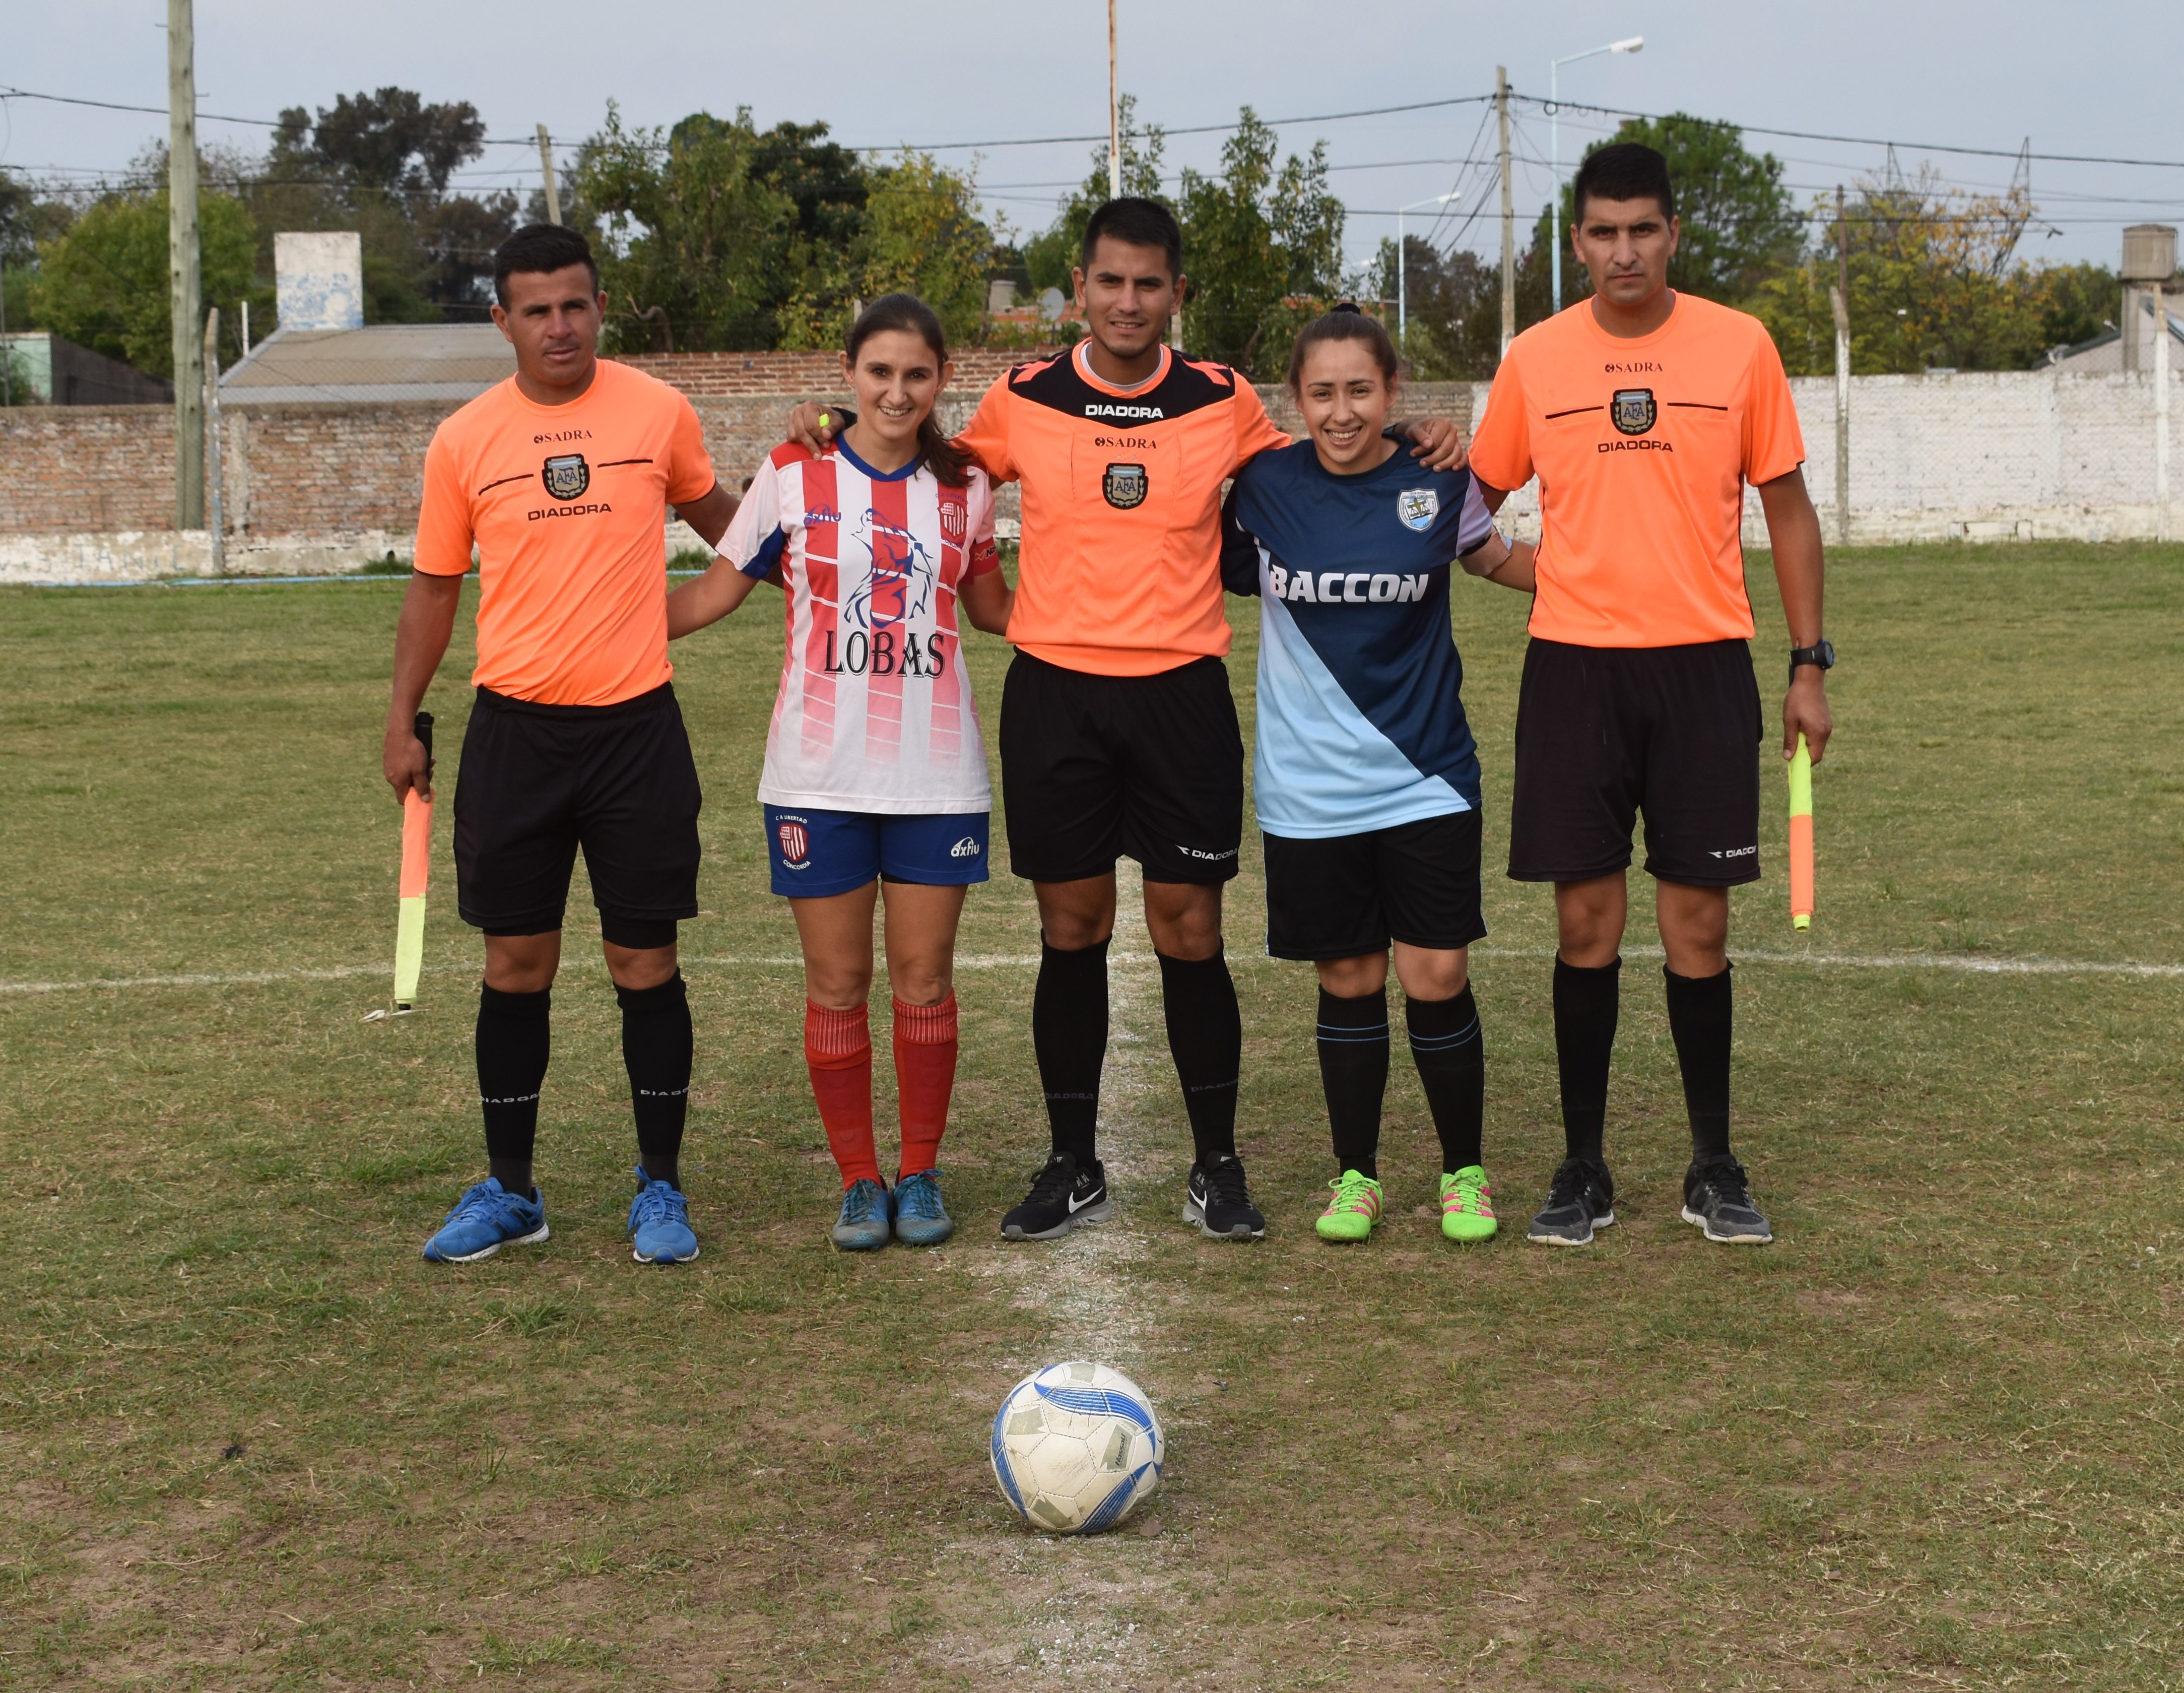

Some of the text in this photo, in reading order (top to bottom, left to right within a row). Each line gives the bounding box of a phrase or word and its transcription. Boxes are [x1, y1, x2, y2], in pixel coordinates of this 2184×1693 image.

[1615, 362, 1663, 373] SADRA
[1085, 405, 1163, 418] DIADORA
[1623, 402, 1645, 420] AFA
[544, 429, 593, 442] SADRA
[1106, 437, 1157, 448] SADRA
[1598, 440, 1673, 453] DIADORA
[556, 467, 578, 485] AFA
[1114, 476, 1137, 495] AFA
[527, 503, 612, 521] DIADORA
[1270, 564, 1429, 603] BACCON
[824, 630, 945, 679] LOBAS
[784, 815, 808, 824] LIBERTAD
[1192, 848, 1237, 861] DIADORA
[783, 859, 811, 870] CONCORDIA
[1045, 1092, 1095, 1100] DIADORA
